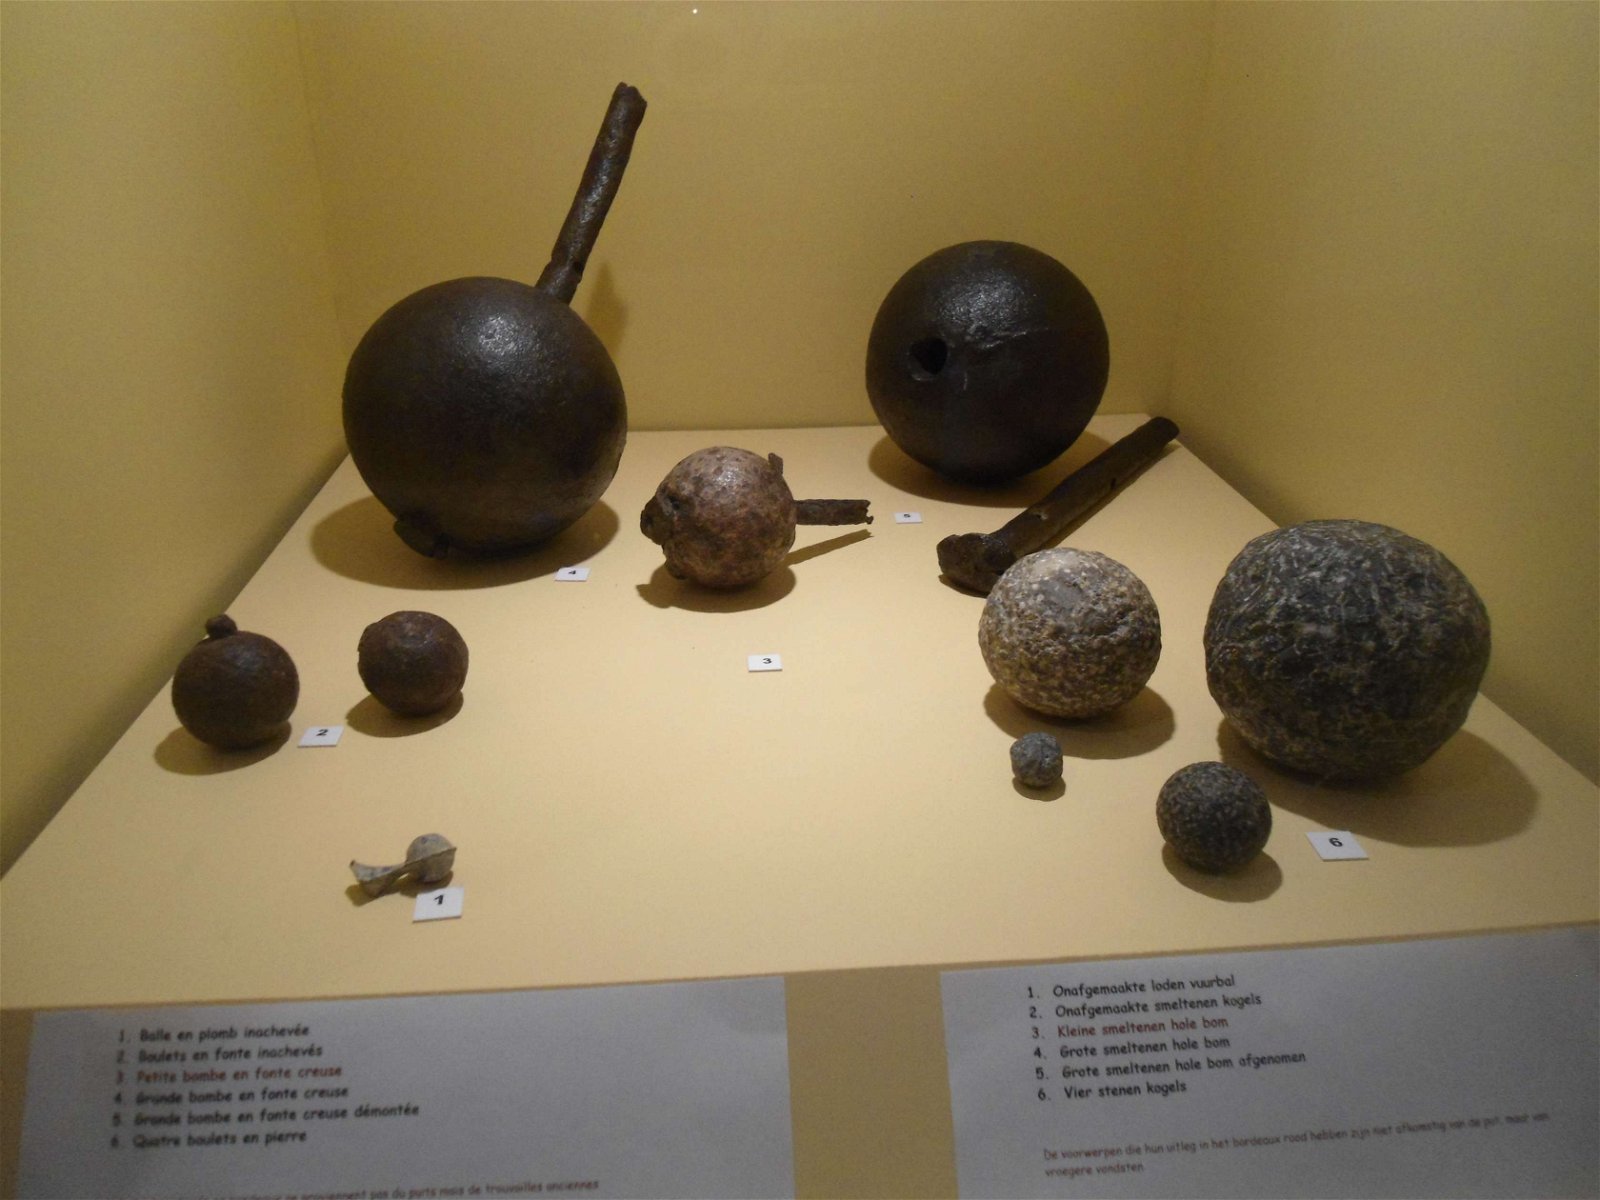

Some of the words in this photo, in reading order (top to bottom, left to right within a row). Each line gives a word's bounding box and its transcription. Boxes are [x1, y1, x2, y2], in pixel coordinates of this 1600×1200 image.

[762, 657, 772, 665] 3
[315, 728, 328, 737] 2
[1328, 836, 1343, 848] 6
[433, 894, 444, 906] 1
[1027, 986, 1040, 999] 1.
[1052, 980, 1146, 999] Onafgemaakte
[1151, 978, 1185, 992] loden
[1189, 974, 1235, 989] vuurbal
[1029, 1006, 1042, 1019] 2.
[1055, 1000, 1149, 1019] Onafgemaakte
[1154, 997, 1218, 1012] smeltenen
[1222, 992, 1261, 1010] kogels
[139, 1028, 171, 1043] Balle
[177, 1031, 193, 1041] en
[199, 1026, 238, 1044] plomb
[244, 1023, 310, 1040] inachevée
[1057, 1023, 1096, 1038] Kleine
[1102, 1020, 1166, 1036] smeltenen
[1170, 1017, 1197, 1030] hole
[1202, 1016, 1229, 1029] bom
[138, 1049, 187, 1064] Boulets
[192, 1051, 208, 1062] en
[215, 1047, 252, 1062] fonte
[257, 1043, 323, 1060] inachevés
[1033, 1046, 1047, 1060] 4.
[1060, 1044, 1097, 1059] Grote
[1103, 1041, 1168, 1056] smeltenen
[1172, 1037, 1199, 1051] hole
[1204, 1036, 1231, 1049] bom
[137, 1069, 177, 1084] Petite
[182, 1067, 227, 1083] bombe
[233, 1070, 249, 1081] en
[255, 1066, 292, 1081] fonte
[297, 1066, 342, 1079] creuse
[1035, 1066, 1049, 1080] 5.
[1062, 1064, 1099, 1079] Grote
[1105, 1061, 1170, 1077] smeltenen
[1174, 1057, 1202, 1072] hole
[1206, 1057, 1234, 1070] bom
[1238, 1052, 1306, 1070] afgenomen
[188, 1088, 233, 1103] bombe
[239, 1090, 256, 1101] en
[261, 1086, 298, 1101] fonte
[303, 1087, 349, 1100] creuse
[1037, 1087, 1051, 1101] 6.
[1064, 1085, 1092, 1099] Vier
[1098, 1084, 1141, 1098] stenen
[1146, 1079, 1187, 1098] kogels
[187, 1109, 231, 1125] bombe
[237, 1111, 254, 1122] en
[260, 1107, 297, 1122] fonte
[303, 1107, 348, 1121] creuse
[354, 1101, 420, 1118] démontée
[187, 1130, 237, 1147] boulets
[242, 1132, 259, 1143] en
[264, 1130, 307, 1147] pierre
[1061, 1149, 1122, 1159] voorwerpen
[1125, 1146, 1142, 1156] die
[1144, 1143, 1164, 1154] hun
[1166, 1140, 1196, 1154] uitleg
[1211, 1138, 1229, 1149] het
[1232, 1136, 1282, 1148] bordeaux
[1283, 1132, 1308, 1144] rood
[1310, 1129, 1348, 1141] hebben
[1045, 1165, 1092, 1179] vroegere
